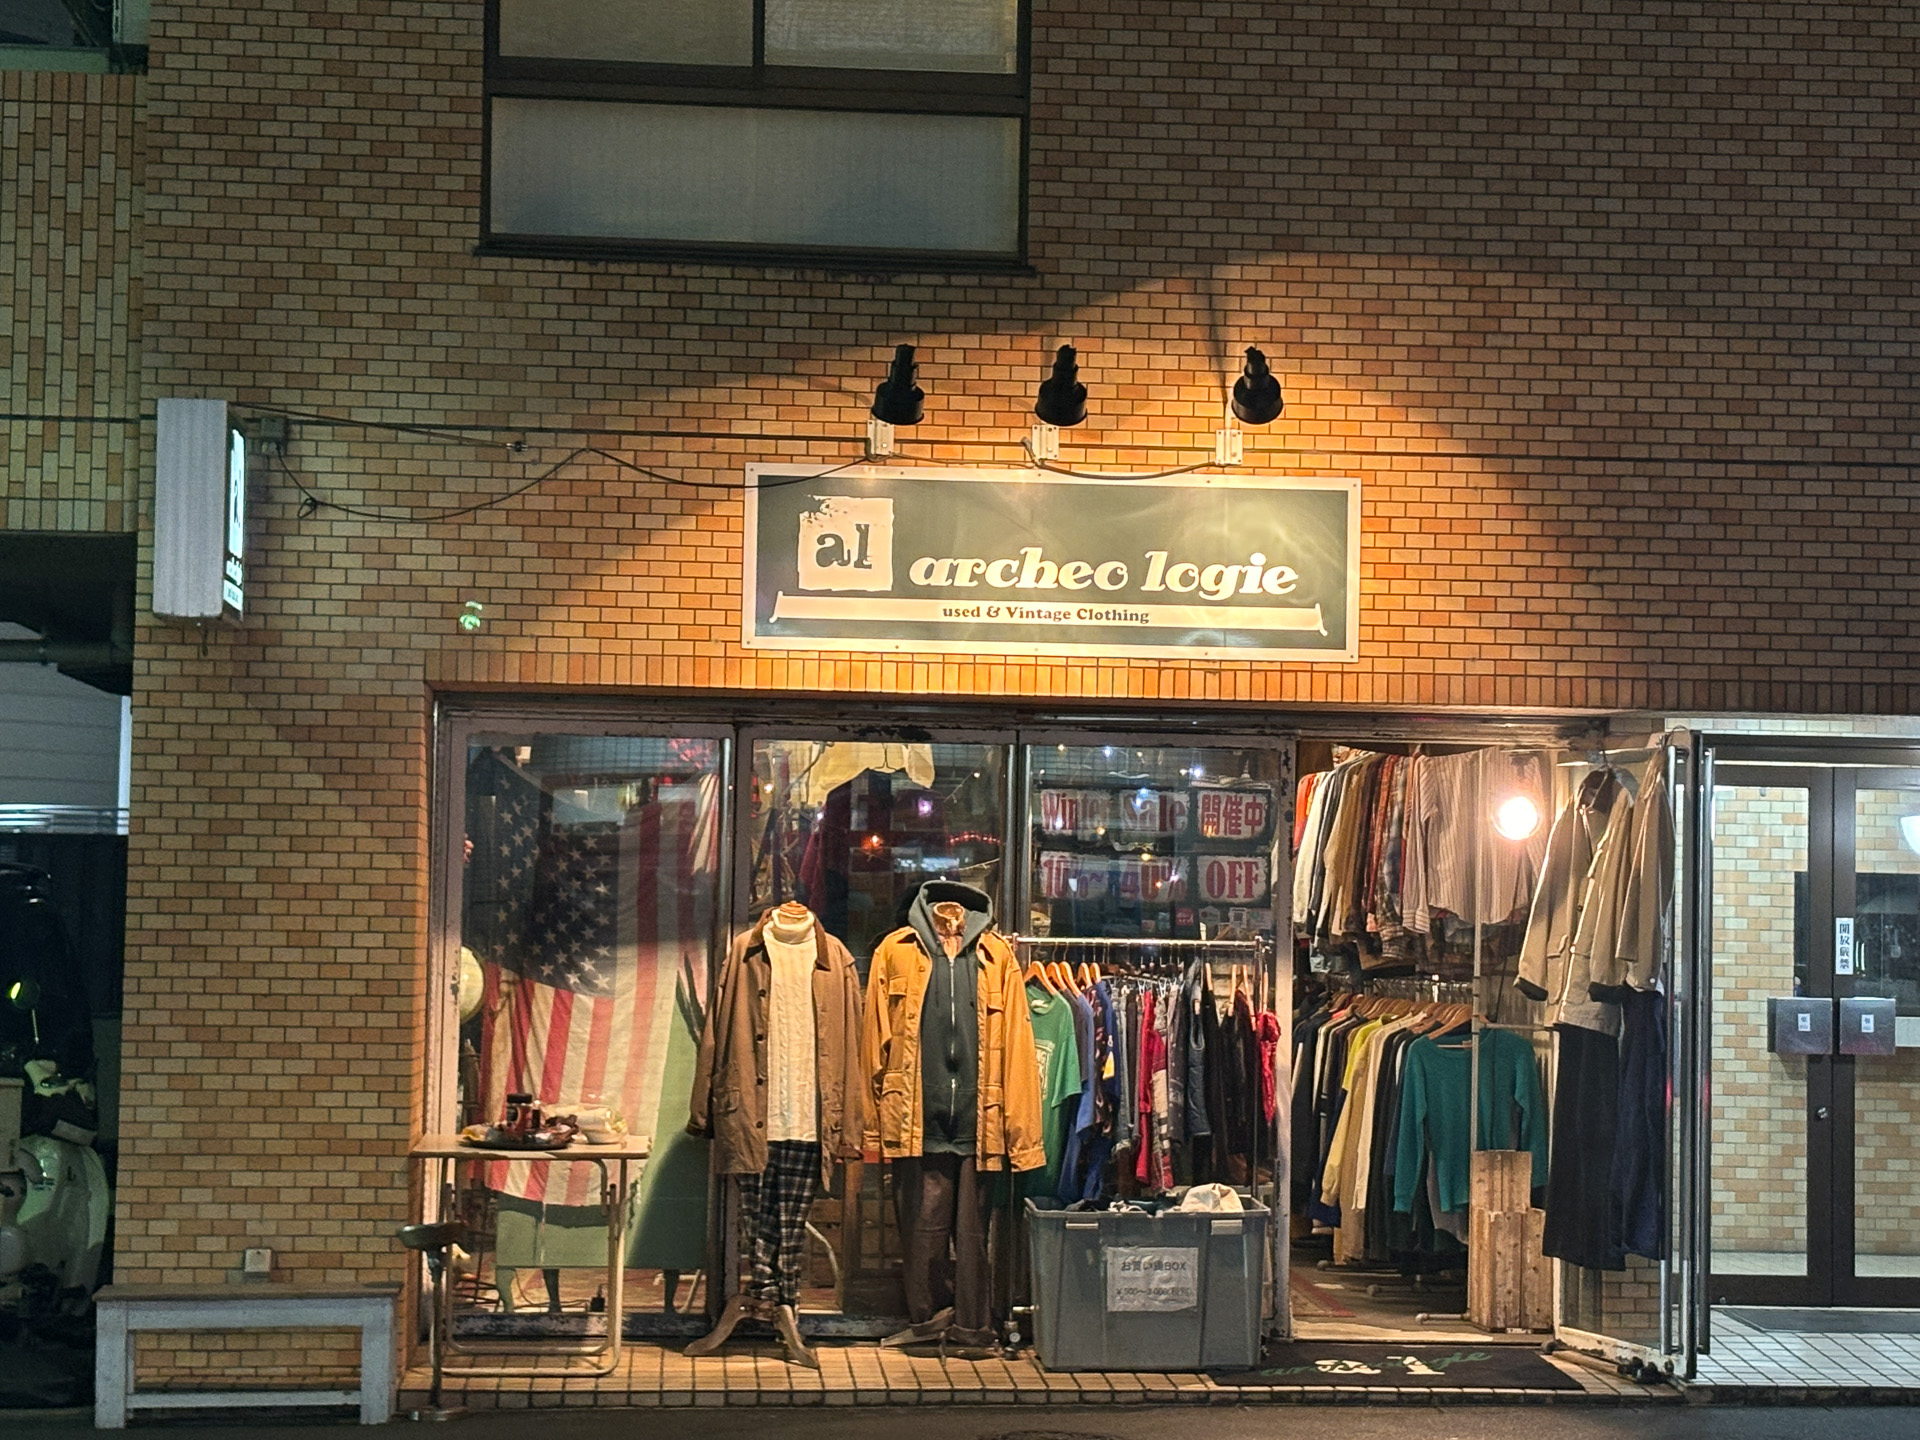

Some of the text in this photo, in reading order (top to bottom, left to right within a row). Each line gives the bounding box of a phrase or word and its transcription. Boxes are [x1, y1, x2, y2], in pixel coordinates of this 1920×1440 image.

[816, 523, 873, 569] al
[909, 546, 1299, 601] archeo logie
[943, 605, 1150, 624] used & Vintage Clothing
[1122, 793, 1188, 832] Sale
[1201, 794, 1263, 836] 開催中
[1206, 860, 1259, 899] OFF
[1839, 923, 1850, 969] 開放厳禁
